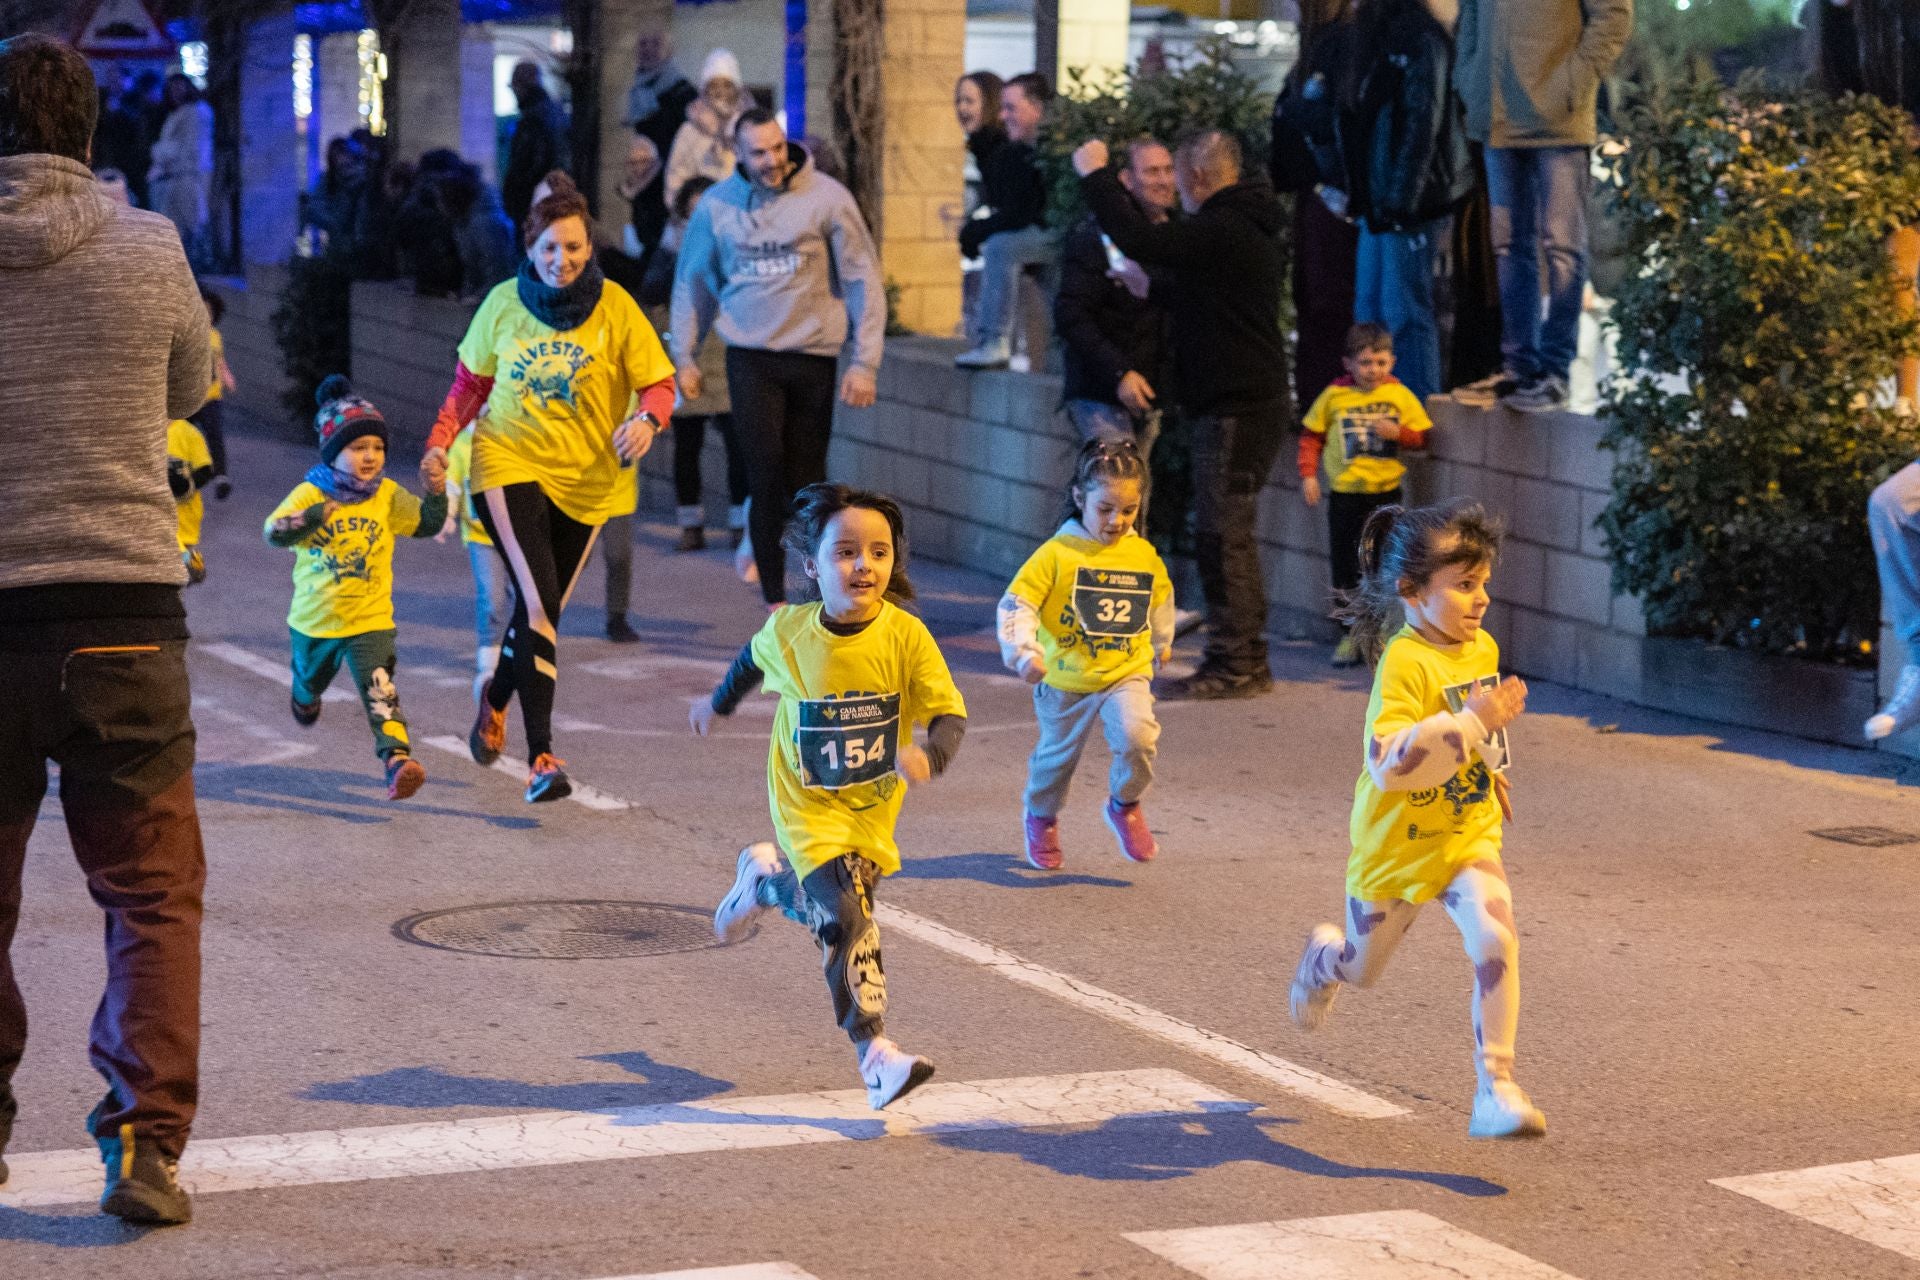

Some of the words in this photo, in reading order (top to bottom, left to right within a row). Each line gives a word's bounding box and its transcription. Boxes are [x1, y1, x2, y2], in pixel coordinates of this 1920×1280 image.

[1096, 598, 1132, 623] 32
[840, 706, 857, 714] CAJA
[857, 704, 880, 713] RURAL
[820, 734, 886, 770] 154
